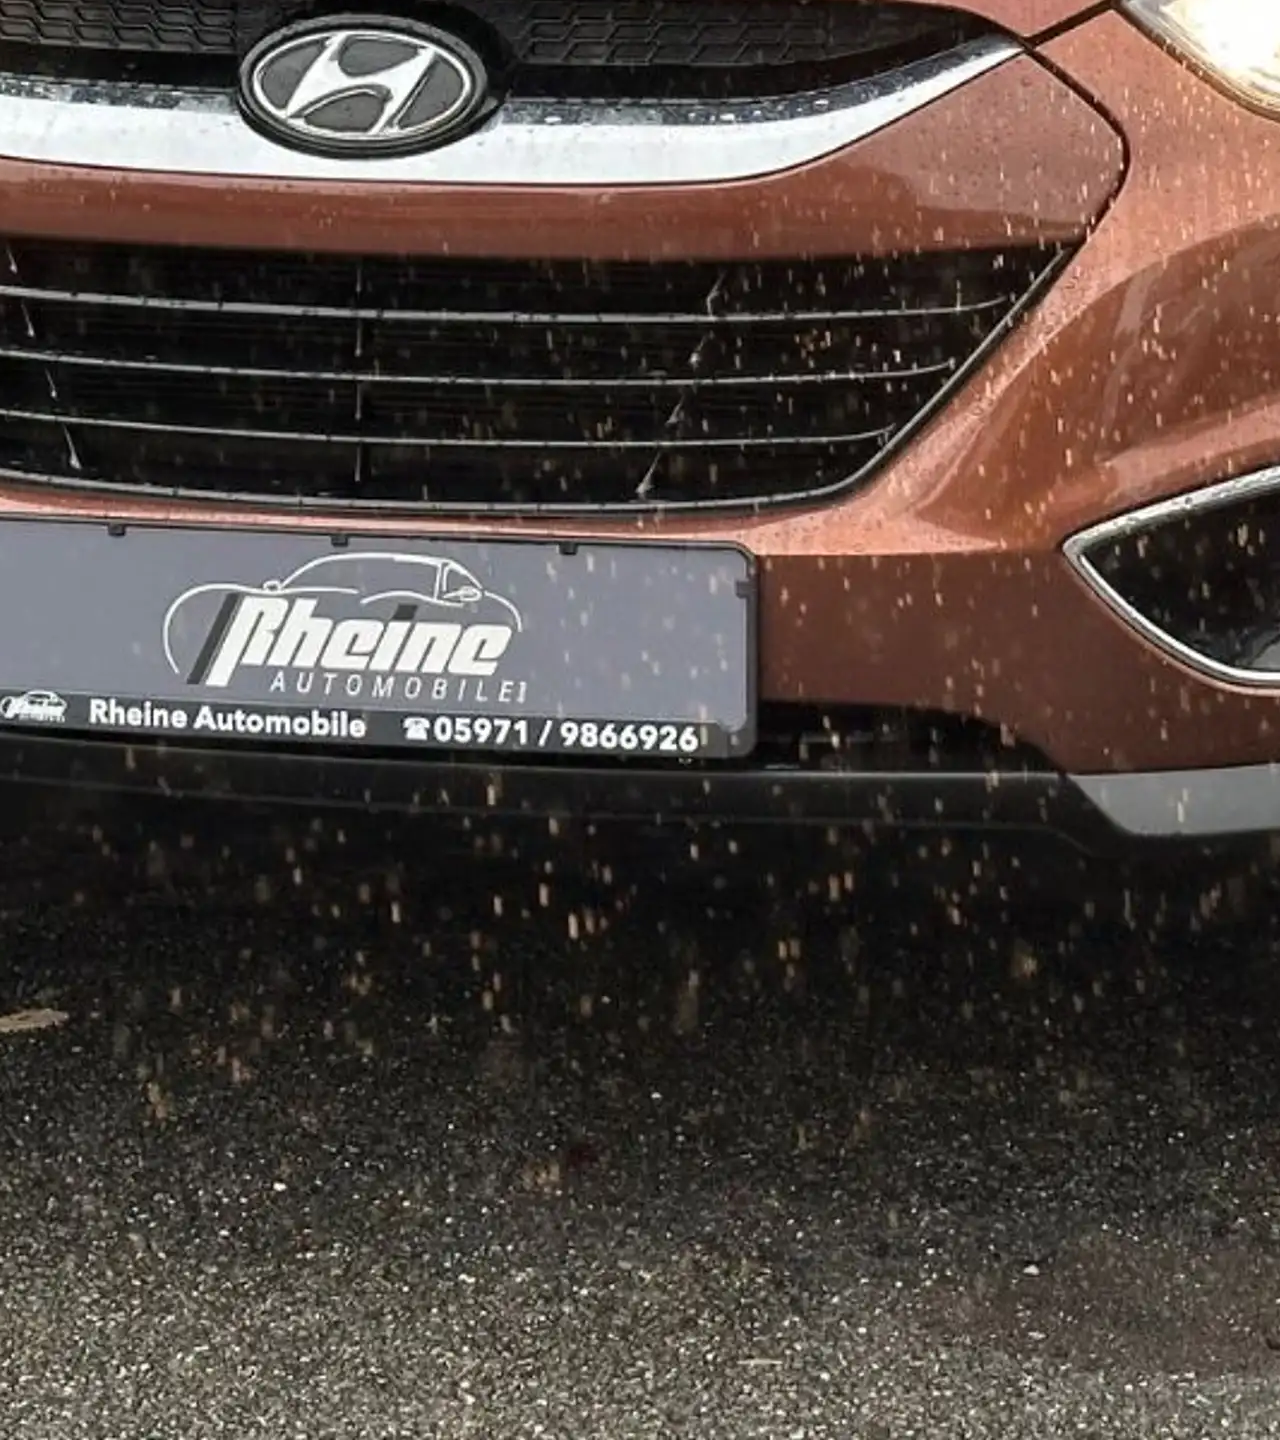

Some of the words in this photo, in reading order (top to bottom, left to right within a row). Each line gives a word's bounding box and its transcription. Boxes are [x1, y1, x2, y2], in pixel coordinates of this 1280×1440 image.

[188, 593, 513, 687] Rheine
[88, 698, 188, 729] Rheine
[193, 705, 368, 738] Automobile
[433, 716, 529, 745] 05971
[559, 722, 700, 752] 9866926
